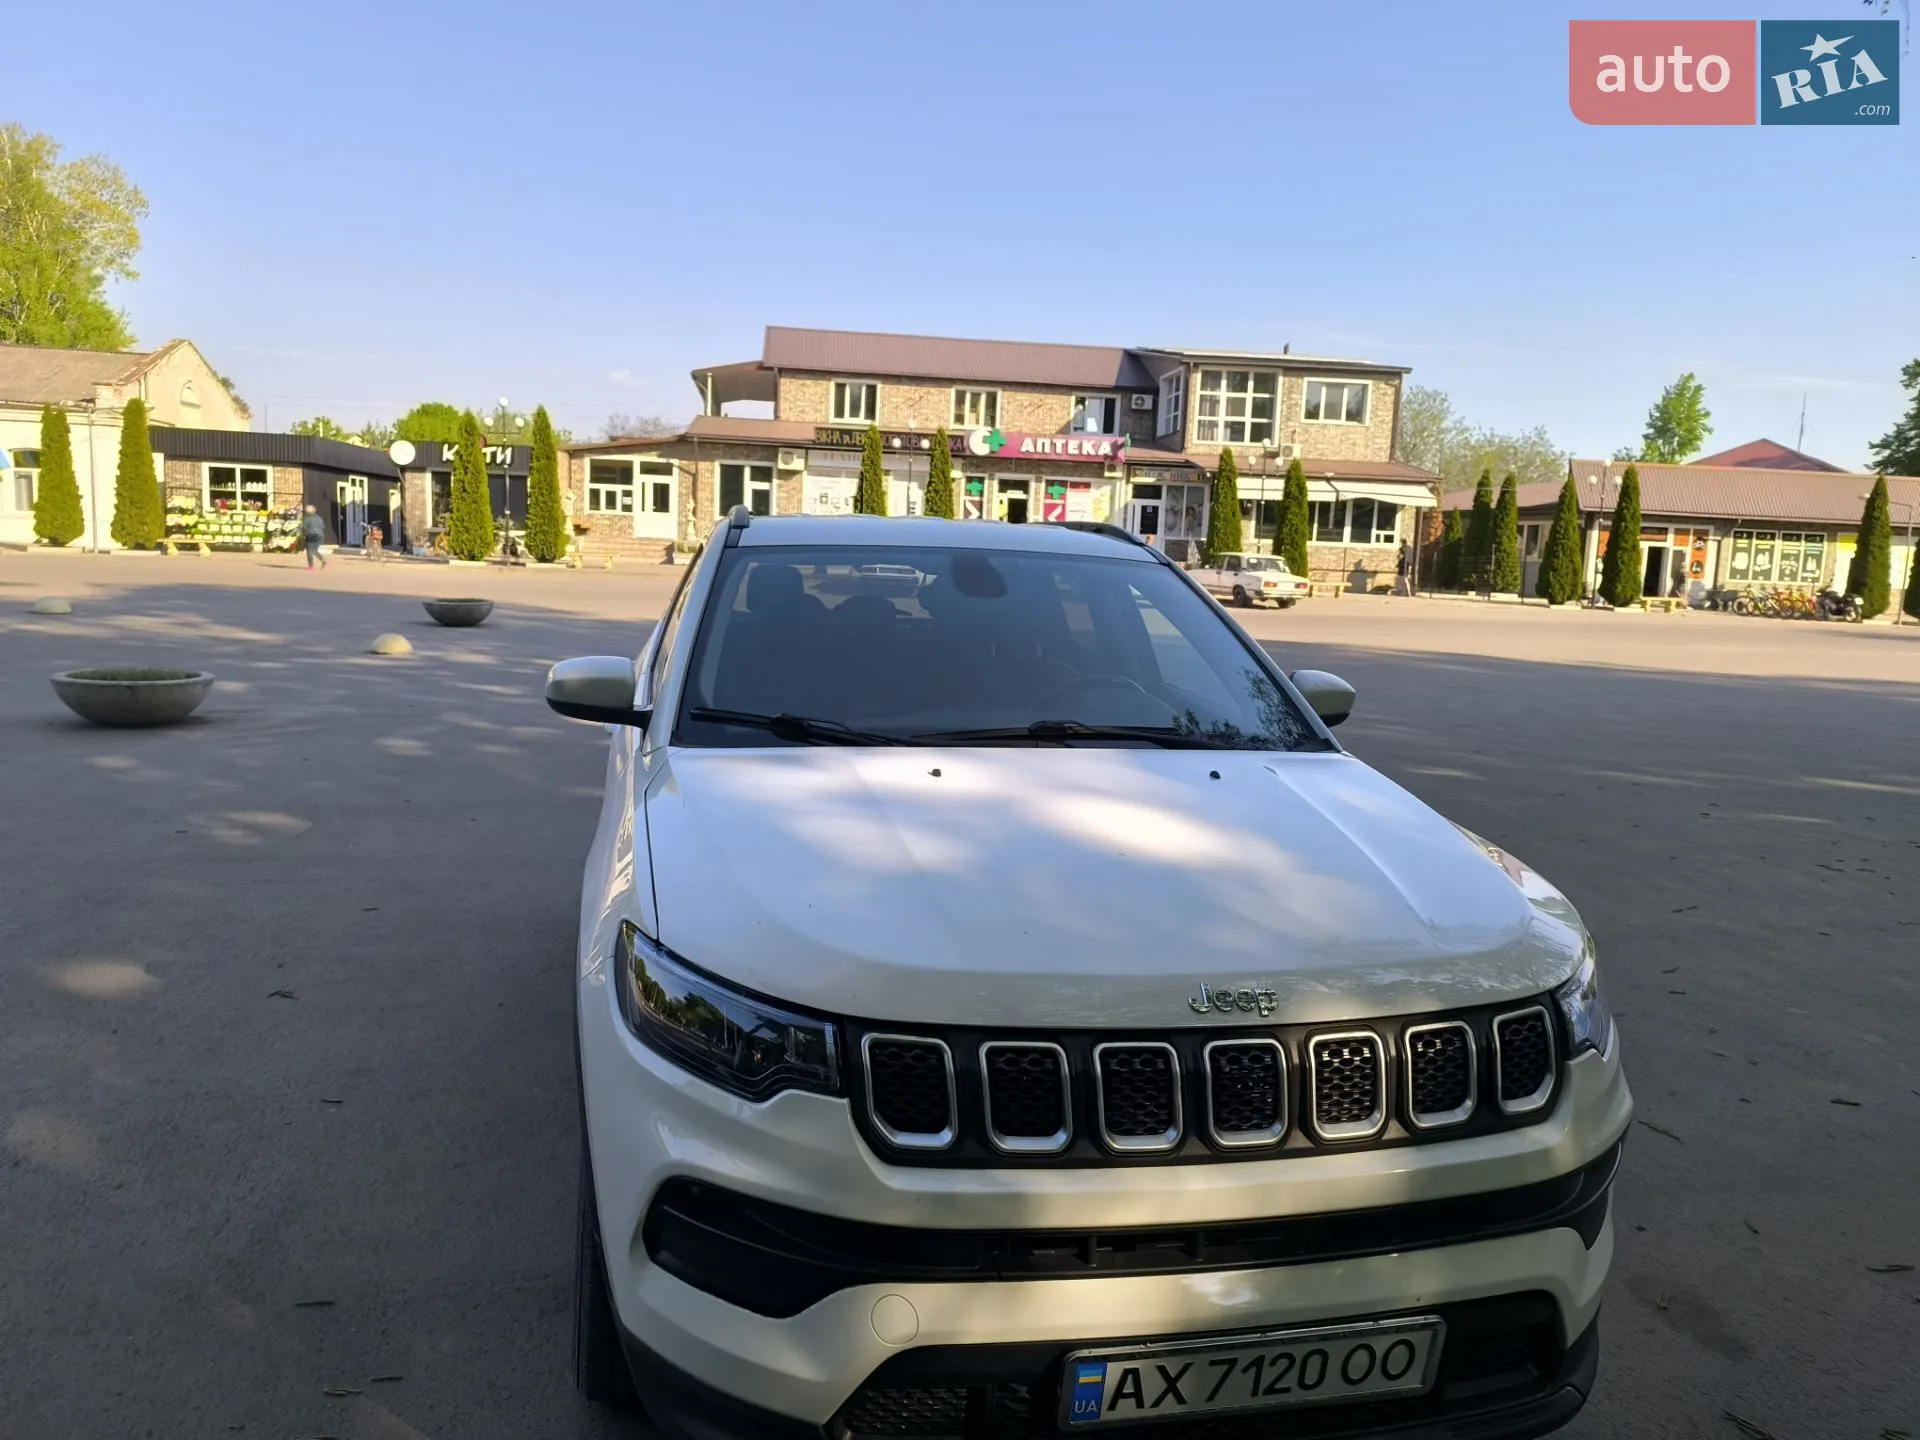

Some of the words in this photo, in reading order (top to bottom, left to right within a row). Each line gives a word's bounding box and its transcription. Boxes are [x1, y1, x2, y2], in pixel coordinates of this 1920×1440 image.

[1020, 437, 1113, 457] АПТЕКА
[1188, 981, 1279, 1017] Jeep
[1106, 1361, 1195, 1412] AX
[1205, 1347, 1330, 1403] 7120
[1340, 1338, 1416, 1386] OO
[1074, 1400, 1098, 1414] UA
